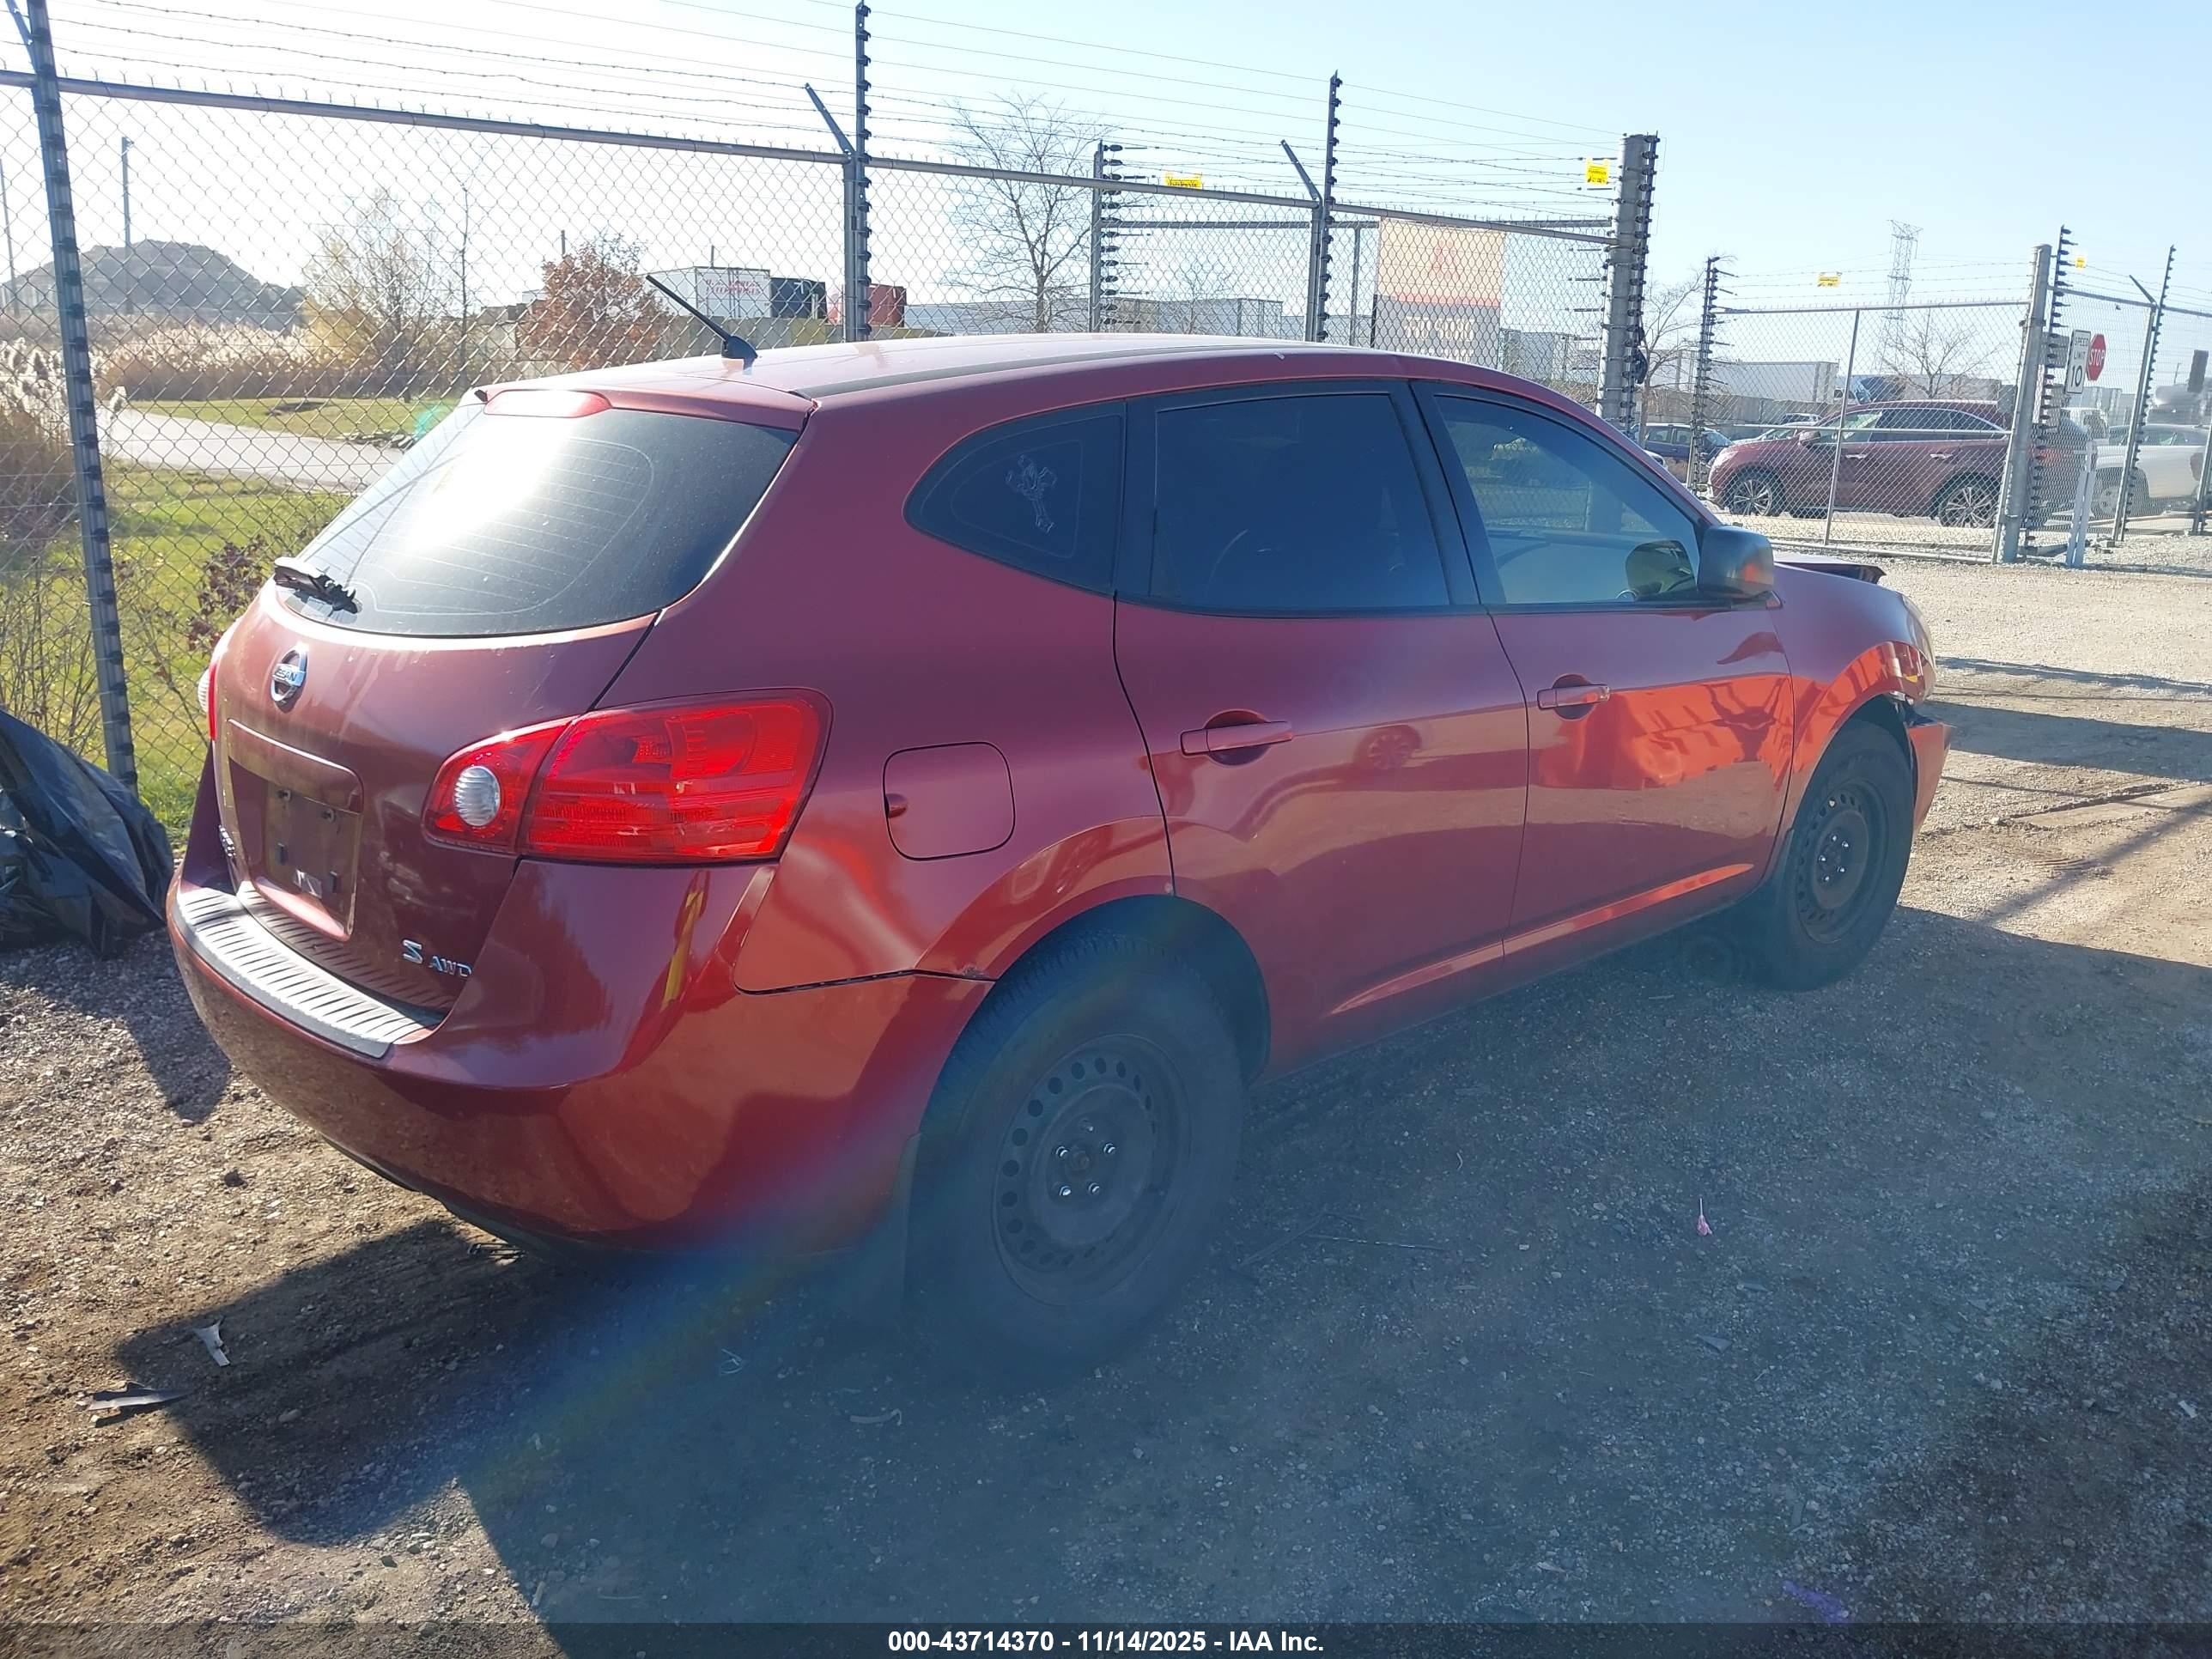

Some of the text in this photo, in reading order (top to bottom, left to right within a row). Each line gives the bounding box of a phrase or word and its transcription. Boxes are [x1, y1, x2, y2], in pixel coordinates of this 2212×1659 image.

[2075, 337, 2089, 347] SPEED
[2089, 349, 2106, 367] STOP
[2070, 365, 2083, 387] 10
[402, 939, 472, 977] S AWD
